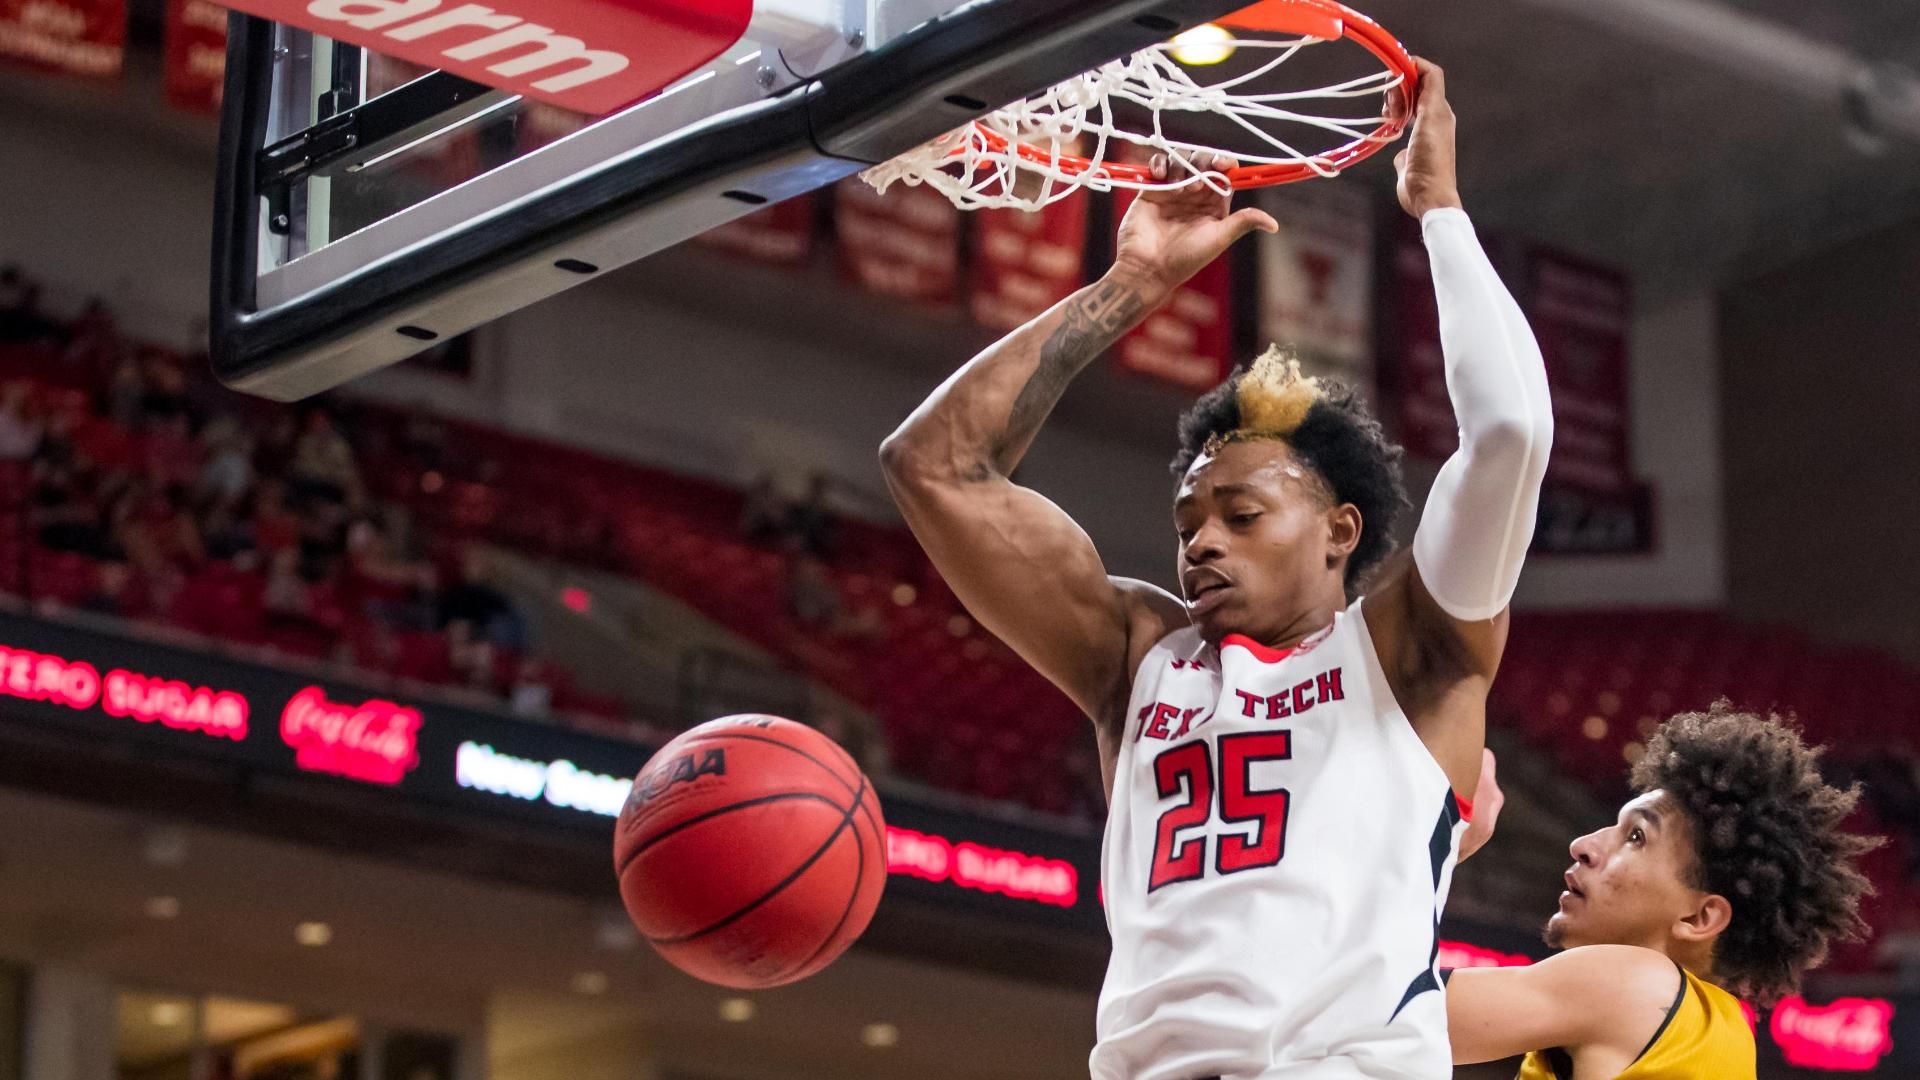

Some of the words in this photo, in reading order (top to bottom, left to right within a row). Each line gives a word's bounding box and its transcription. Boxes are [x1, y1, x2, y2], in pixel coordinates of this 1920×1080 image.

[1134, 701, 1215, 744] TEX
[1235, 667, 1345, 720] TECH
[626, 747, 727, 811] NCAA
[1148, 729, 1292, 894] 25
